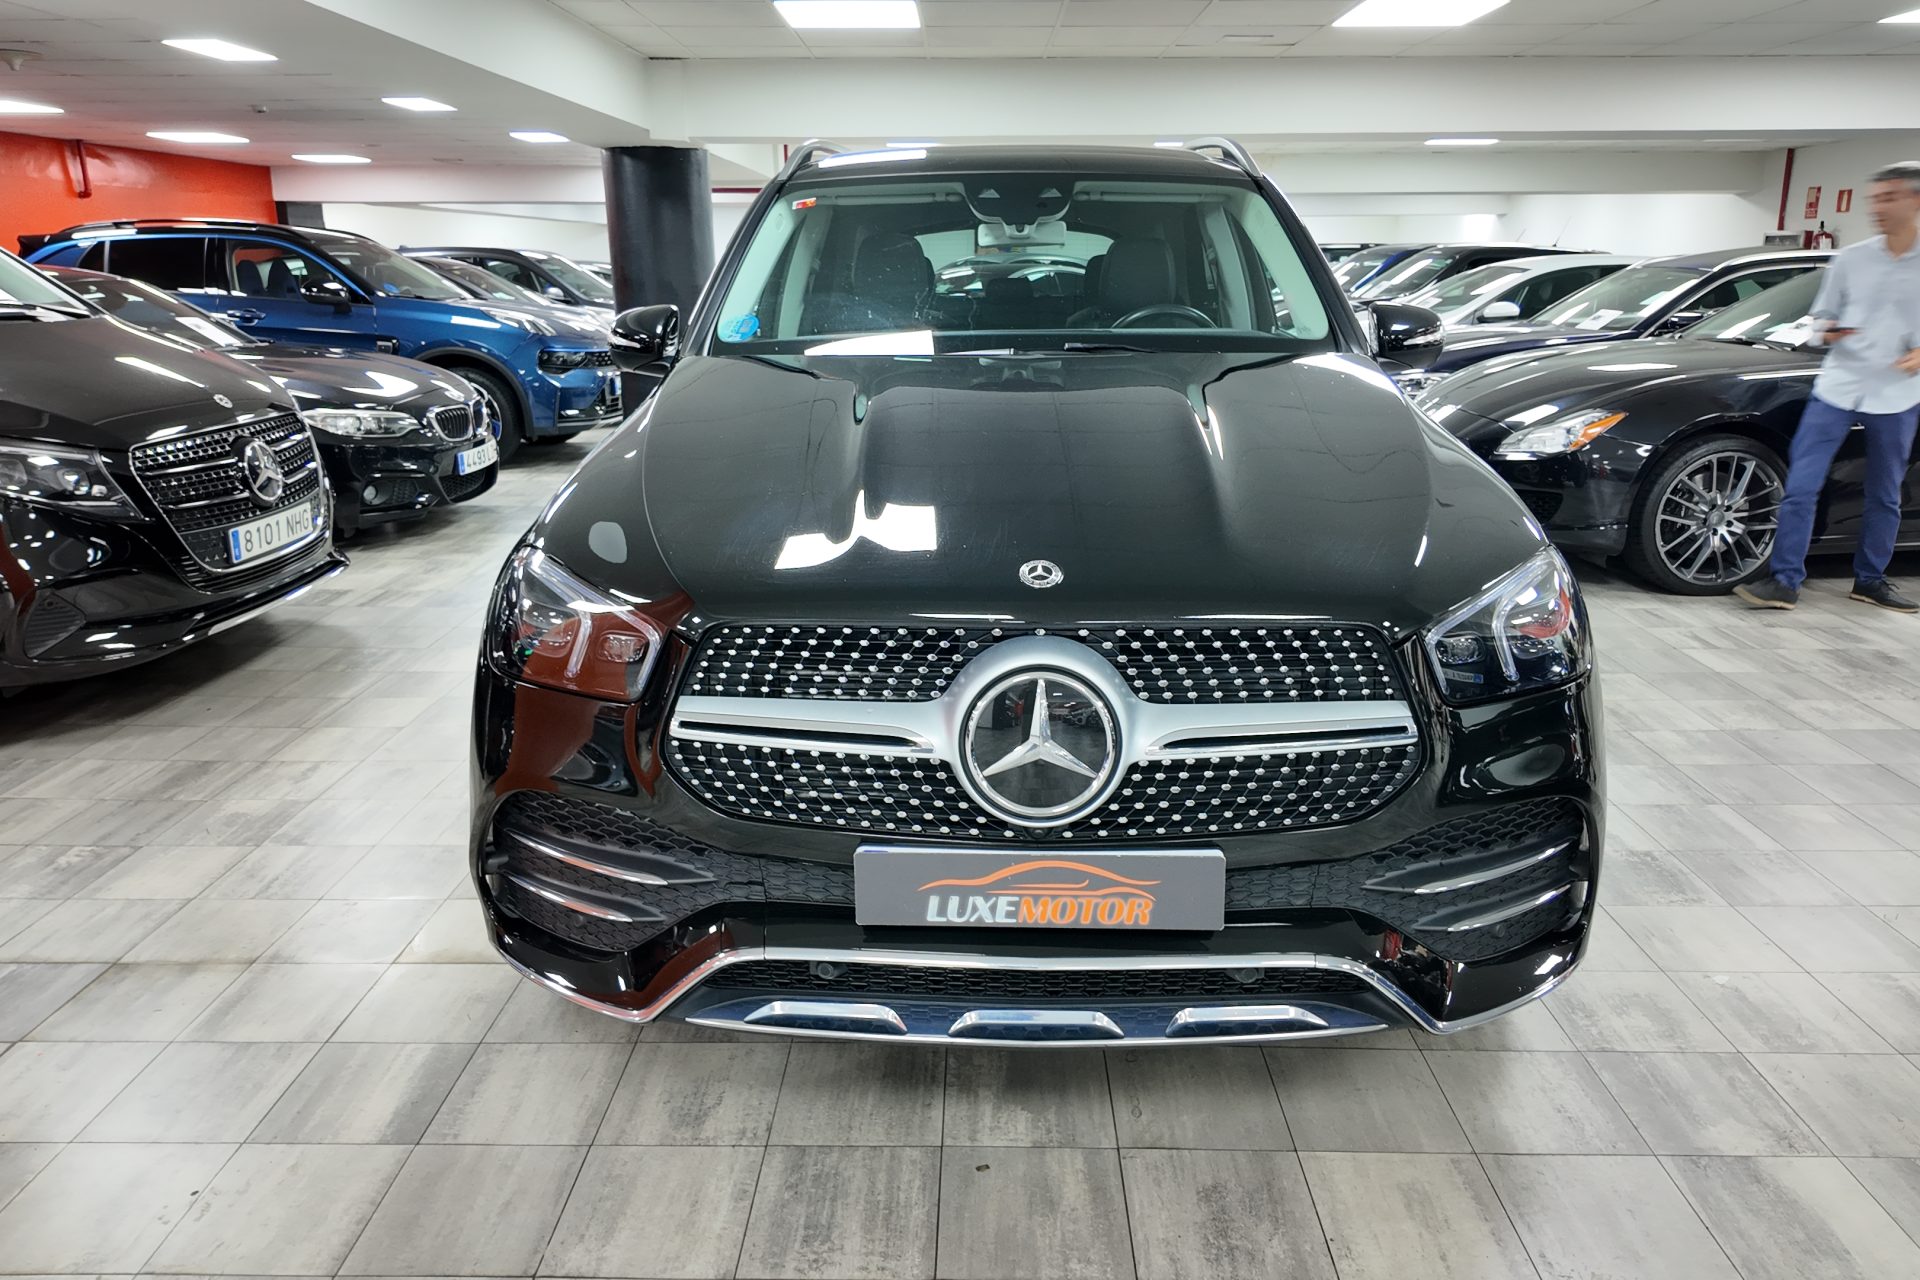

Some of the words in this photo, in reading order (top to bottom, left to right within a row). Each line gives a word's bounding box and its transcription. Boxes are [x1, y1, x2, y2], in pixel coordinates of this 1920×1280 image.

[244, 519, 280, 552] 8101
[286, 508, 309, 537] NHG
[926, 894, 1153, 926] LUXEMOTOR
